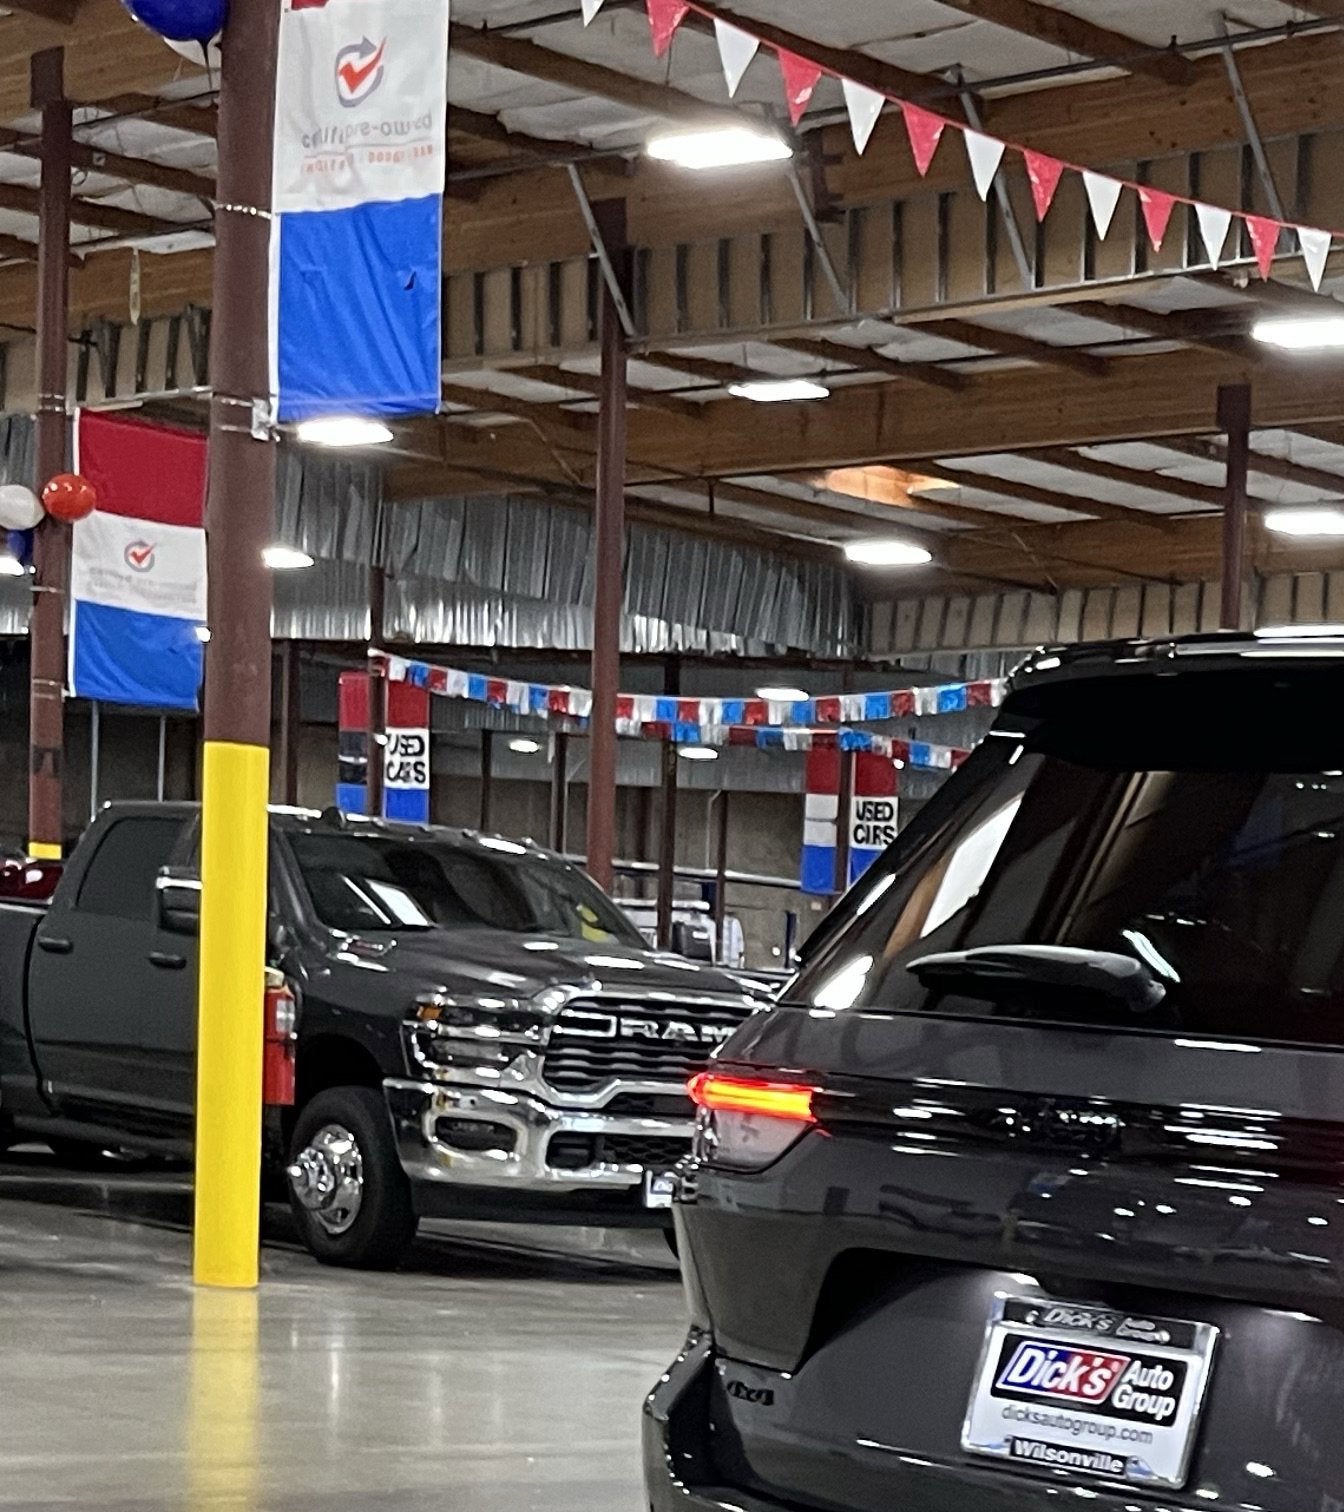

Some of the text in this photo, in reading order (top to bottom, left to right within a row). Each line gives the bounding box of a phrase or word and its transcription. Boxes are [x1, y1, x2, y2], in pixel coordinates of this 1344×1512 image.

[855, 801, 894, 822] USED
[1008, 1348, 1113, 1397] Dick's
[1121, 1360, 1174, 1391] Auto
[1111, 1384, 1176, 1421] Group
[1001, 1404, 1154, 1445] dicksautogroup.com
[1014, 1439, 1125, 1473] Wilsonville
